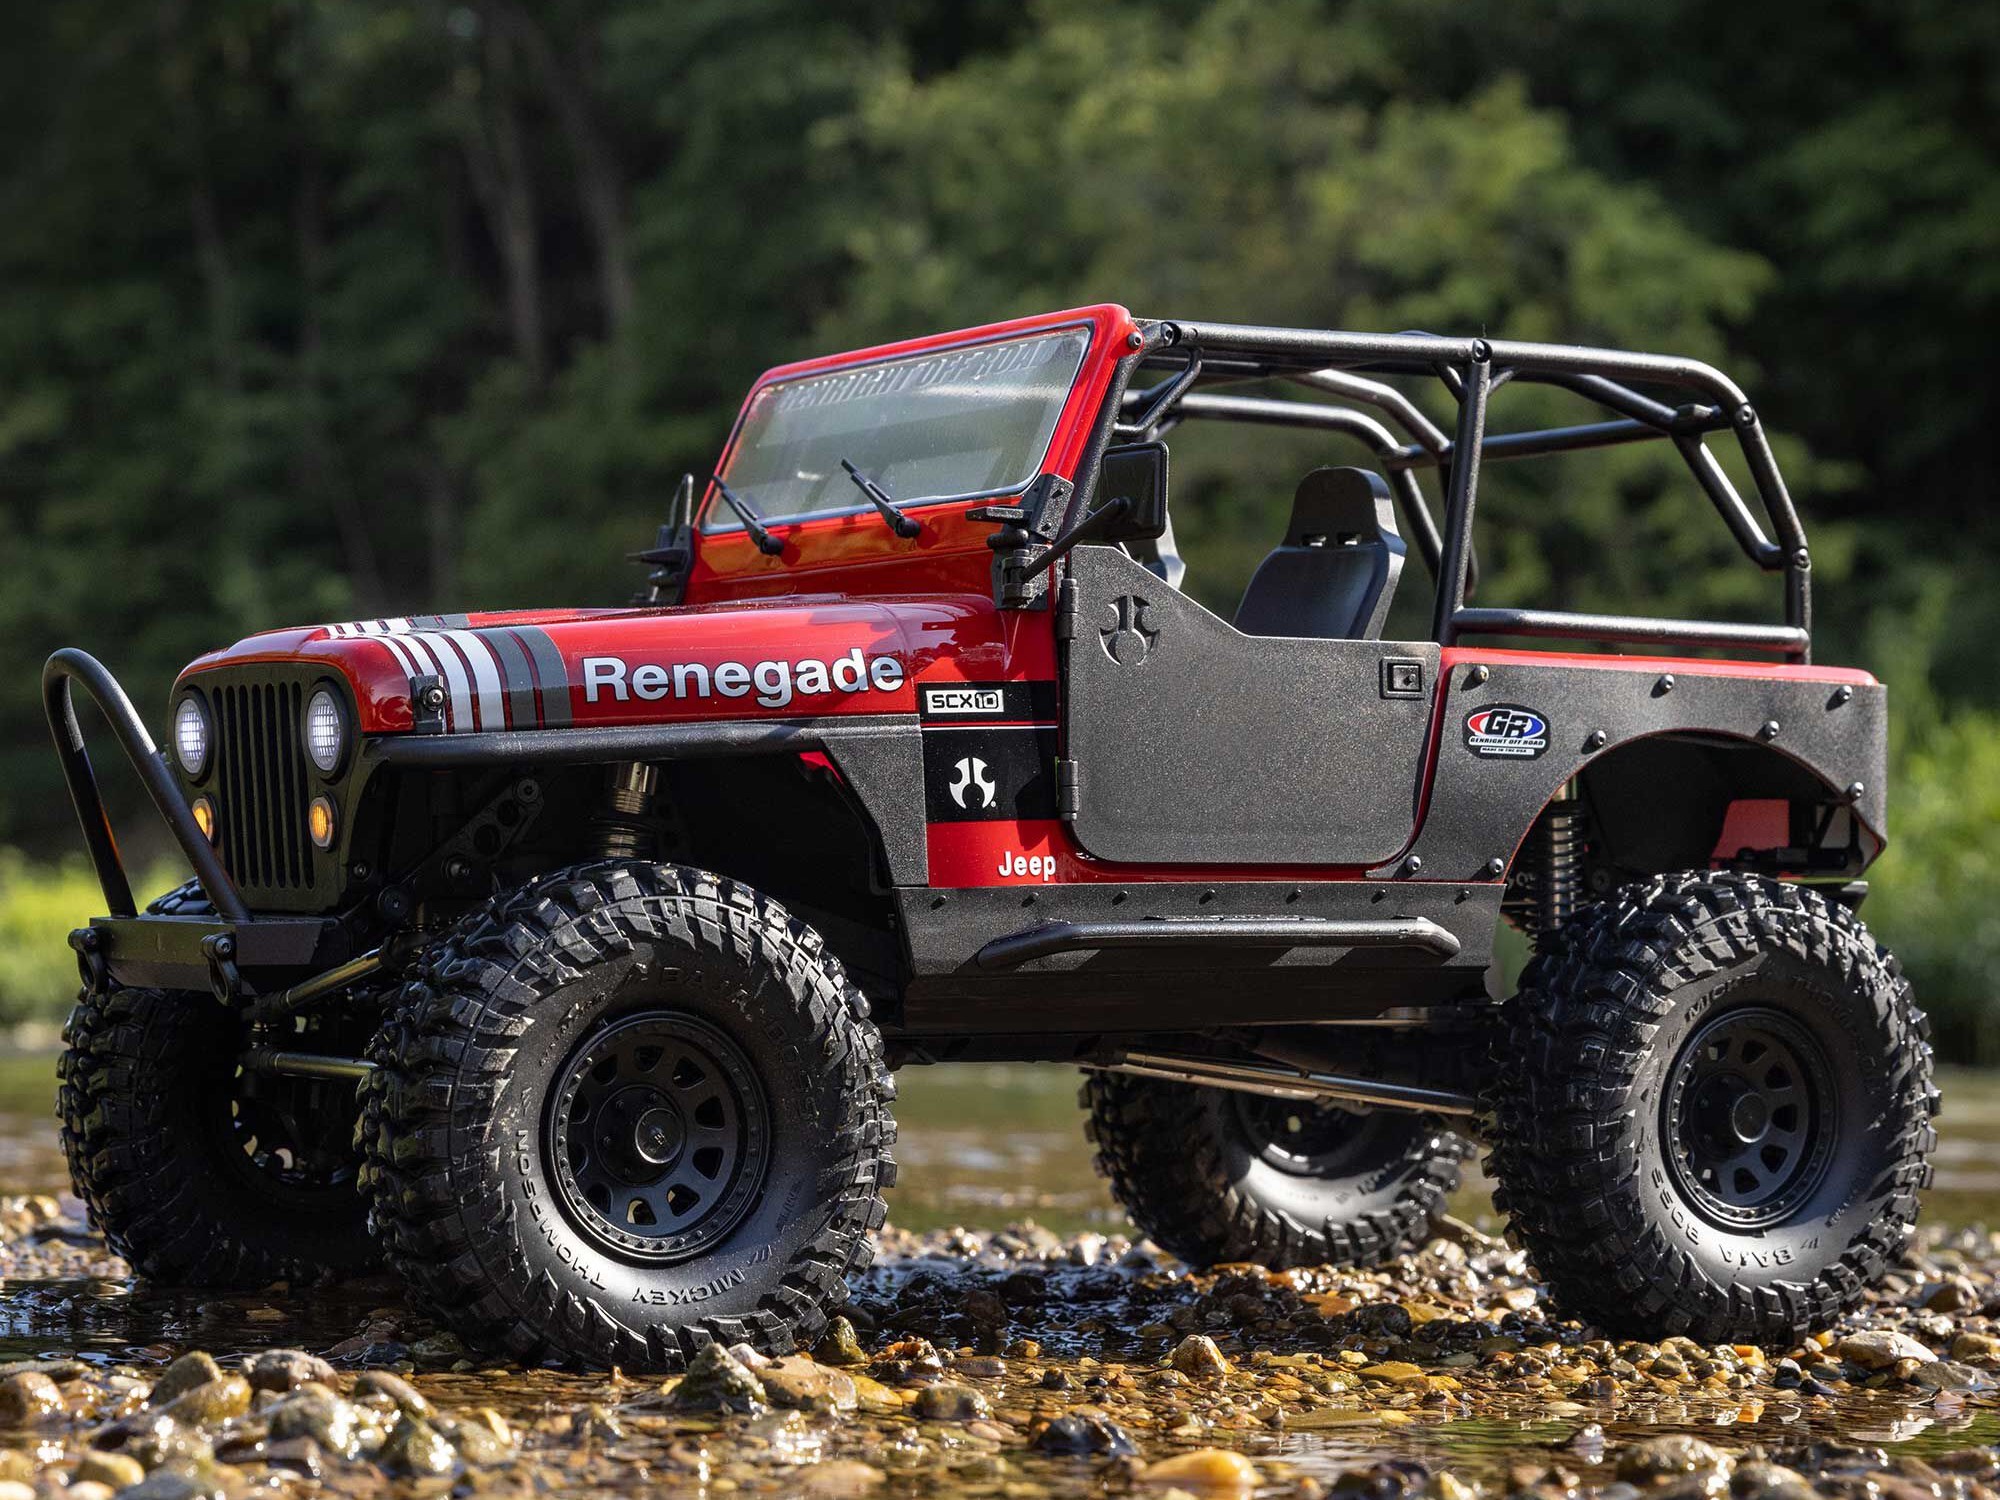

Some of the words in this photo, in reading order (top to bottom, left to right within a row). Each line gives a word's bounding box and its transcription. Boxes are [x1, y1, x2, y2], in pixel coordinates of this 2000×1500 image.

[582, 648, 905, 708] Renegade
[931, 691, 999, 711] SCX10
[1485, 710, 1528, 738] GR
[998, 850, 1056, 882] Jeep
[515, 1128, 607, 1292] THOMPSON
[1651, 1167, 1700, 1246] BOSS
[1719, 1243, 1797, 1267] BAJA
[632, 1267, 746, 1306] MICKEY
